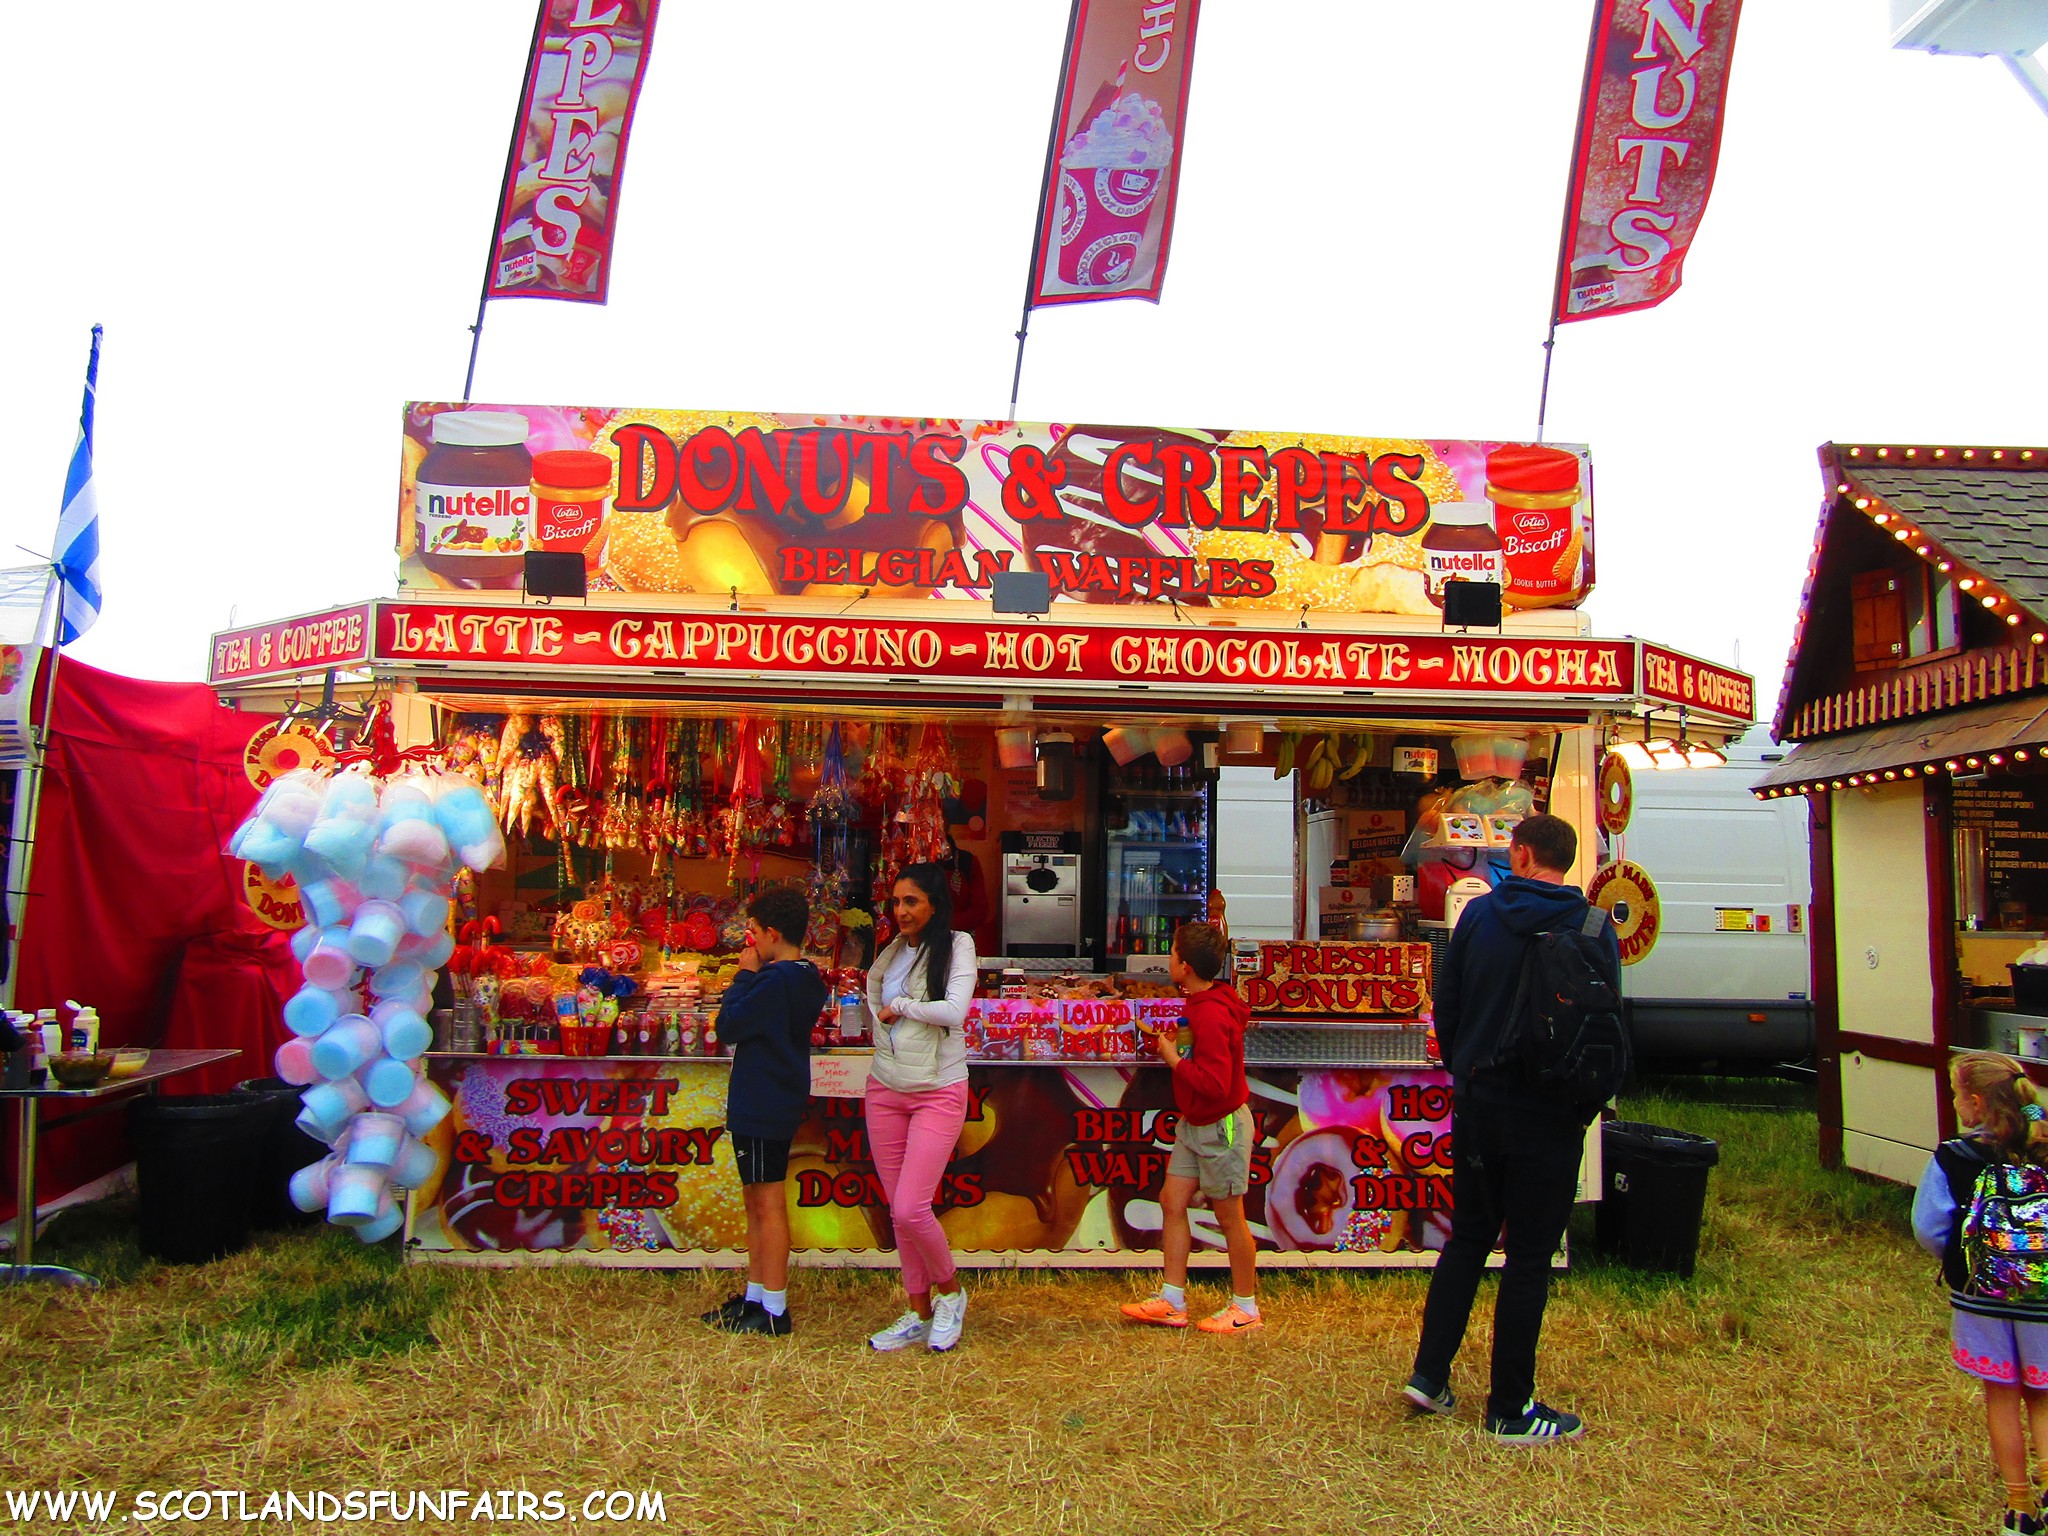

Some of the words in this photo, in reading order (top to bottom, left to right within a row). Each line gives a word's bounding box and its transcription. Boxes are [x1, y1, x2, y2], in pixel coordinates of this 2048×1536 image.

[1133, 0, 1176, 73] CH
[1577, 283, 1614, 300] nutella
[611, 423, 969, 515] DONUTS
[1001, 444, 1066, 525] &
[1100, 444, 1431, 538] CREPES
[428, 490, 529, 516] nutella
[556, 507, 580, 518] Lotus
[542, 518, 597, 541] Biscoff
[1519, 515, 1545, 528] Lotus
[1503, 529, 1566, 556] Biscoff
[779, 546, 1013, 588] BELGIAN
[1036, 551, 1277, 599] WAFFLES
[1430, 553, 1495, 571] nutella
[1513, 577, 1534, 588] COOKIE
[1536, 579, 1558, 589] BUTTER
[217, 636, 251, 674] TEA
[258, 633, 272, 668] &
[278, 613, 363, 663] COFFEE
[391, 612, 564, 656] LATTE
[609, 620, 942, 669] CAPPUCCINO
[983, 631, 1090, 673] HOT
[1109, 635, 1411, 682] CHOCOLATE
[1448, 645, 1622, 687] MOCHA
[1646, 652, 1678, 695] TEA
[1683, 665, 1694, 699] &
[1698, 669, 1750, 714] COFFEE
[1404, 750, 1436, 760] nutella
[1352, 839, 1377, 849] BELGIAN
[1622, 864, 1655, 902] MADE
[1261, 945, 1402, 976] FRESH
[1001, 986, 1027, 994] nutella
[1244, 978, 1421, 1010] DONUTS
[988, 1012, 1054, 1025] BELGIAN
[1063, 1004, 1131, 1026] LOADED
[987, 1027, 1058, 1041] WAFFLES
[1063, 1031, 1135, 1053] DONUTS
[506, 1078, 679, 1116] SWEET
[1388, 1084, 1454, 1121] HO
[455, 1129, 493, 1164] &
[508, 1127, 725, 1165] SAVOURY
[1351, 1134, 1388, 1169] &
[494, 1170, 679, 1208] CREPES
[796, 1169, 985, 1208] DONTS
